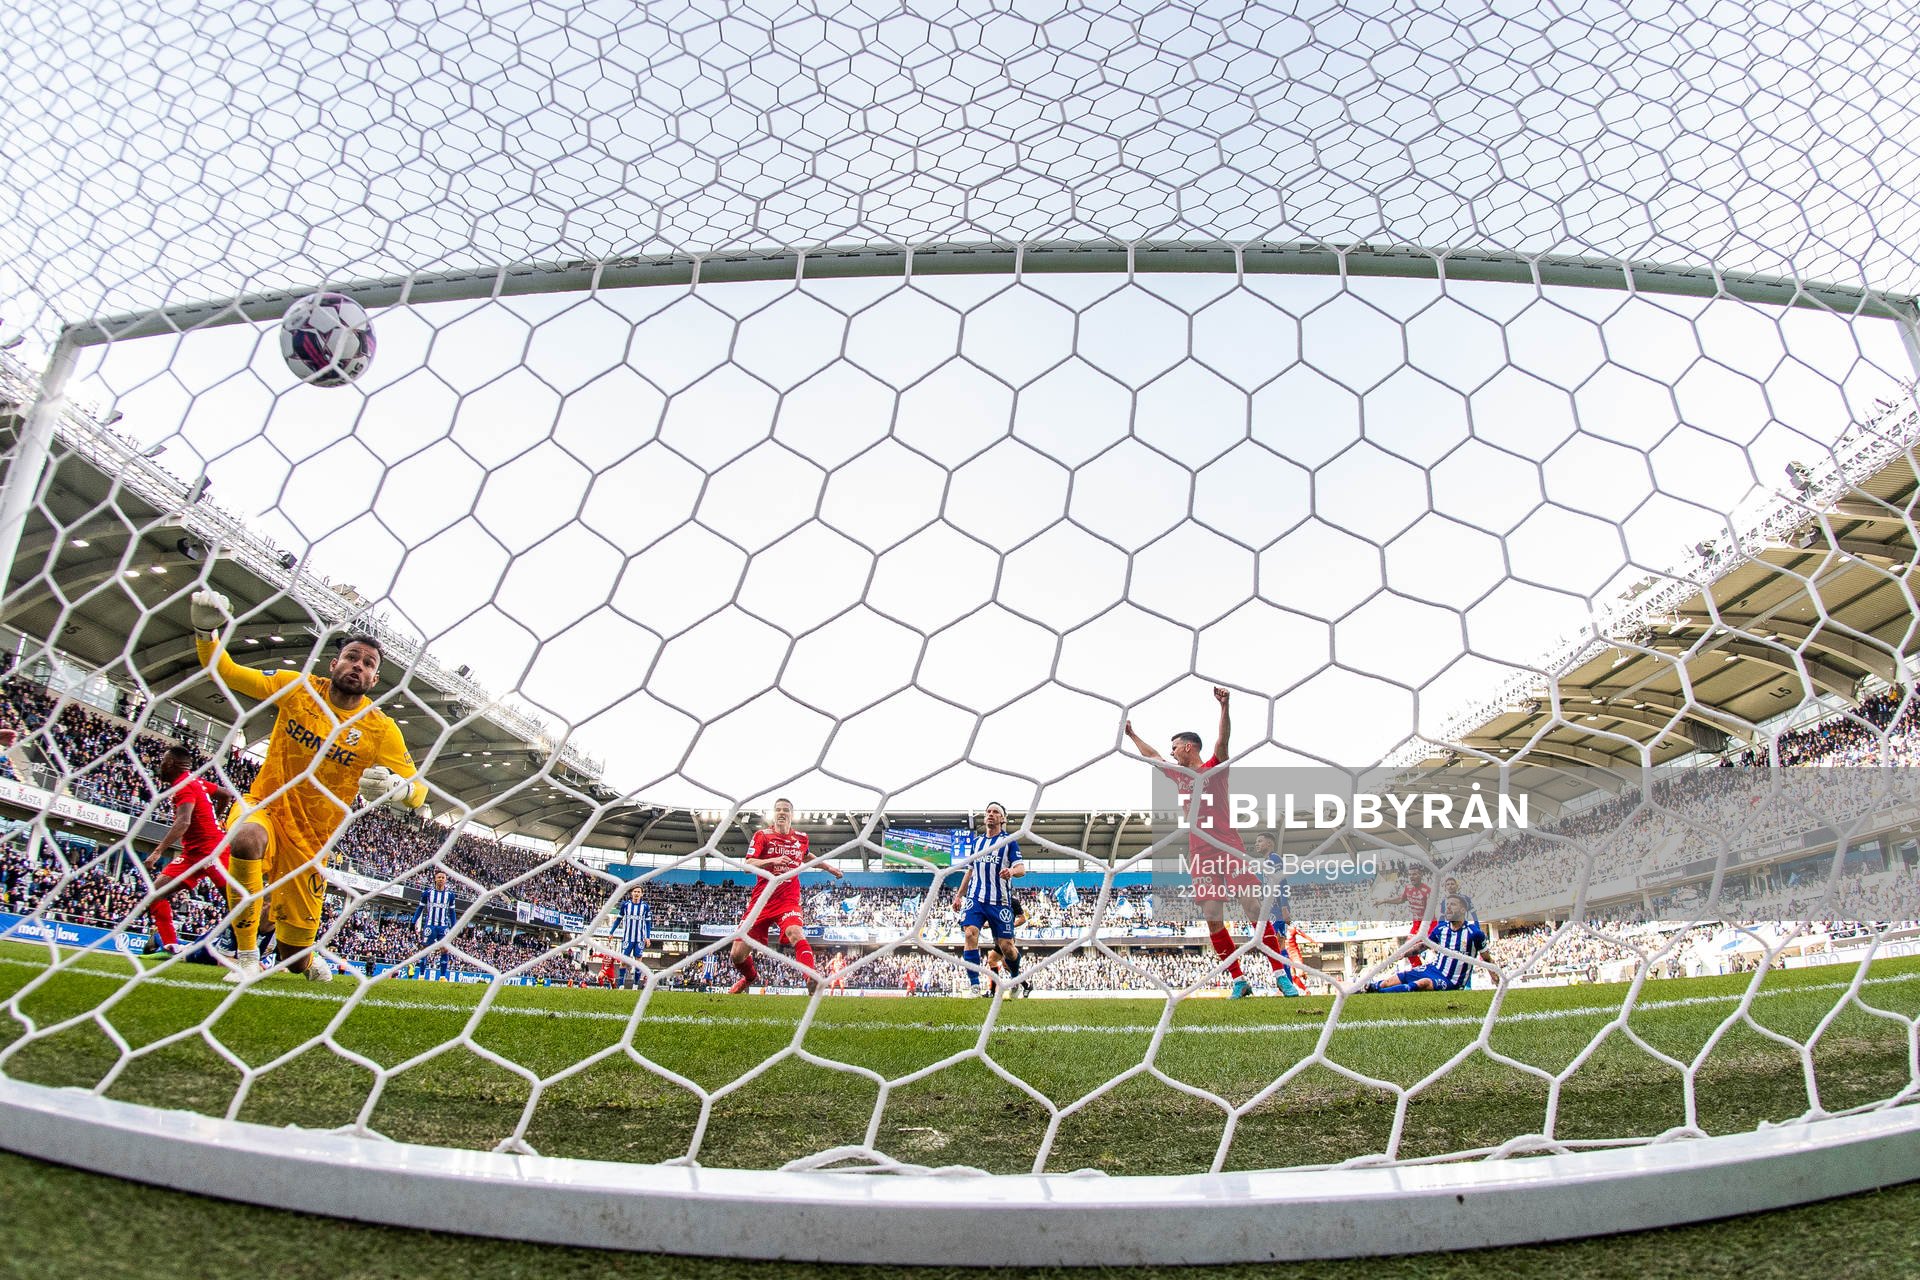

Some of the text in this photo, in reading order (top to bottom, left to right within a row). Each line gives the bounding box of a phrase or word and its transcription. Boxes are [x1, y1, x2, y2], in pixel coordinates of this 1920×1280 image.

[1769, 686, 1793, 699] L5
[285, 719, 358, 766] SERNEKE
[1655, 740, 1675, 751] L4
